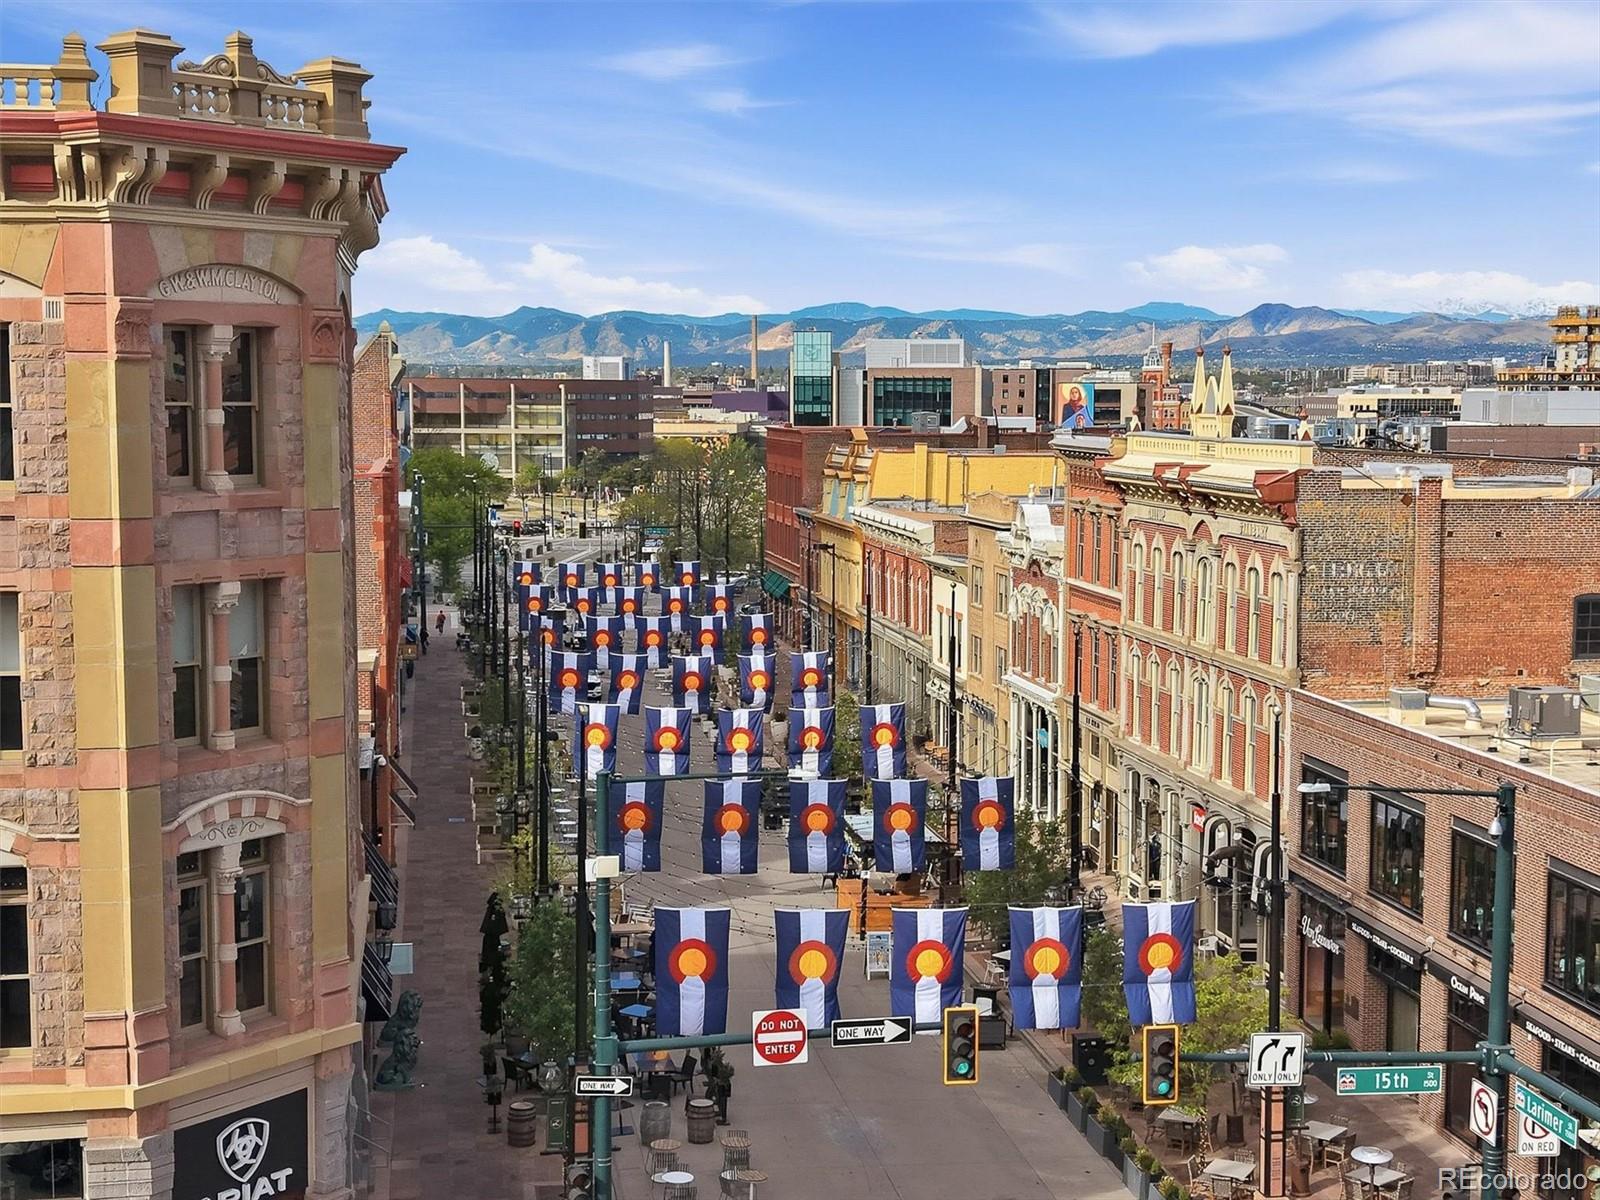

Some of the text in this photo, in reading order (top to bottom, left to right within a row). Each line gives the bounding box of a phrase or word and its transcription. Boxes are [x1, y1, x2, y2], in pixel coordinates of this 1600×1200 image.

[761, 1019, 799, 1031] DO NOT
[838, 1027, 885, 1039] ONE WAY
[1526, 1021, 1552, 1041] SEAFOOD
[1554, 1038, 1575, 1057] STEAKS
[765, 1044, 796, 1055] ENTER
[1252, 1074, 1298, 1082] ONLY ONLY
[1375, 1072, 1409, 1089] 15th
[1527, 1096, 1564, 1133] Larimer
[1521, 1142, 1555, 1152] ON RED
[200, 1167, 293, 1200] RIAT
